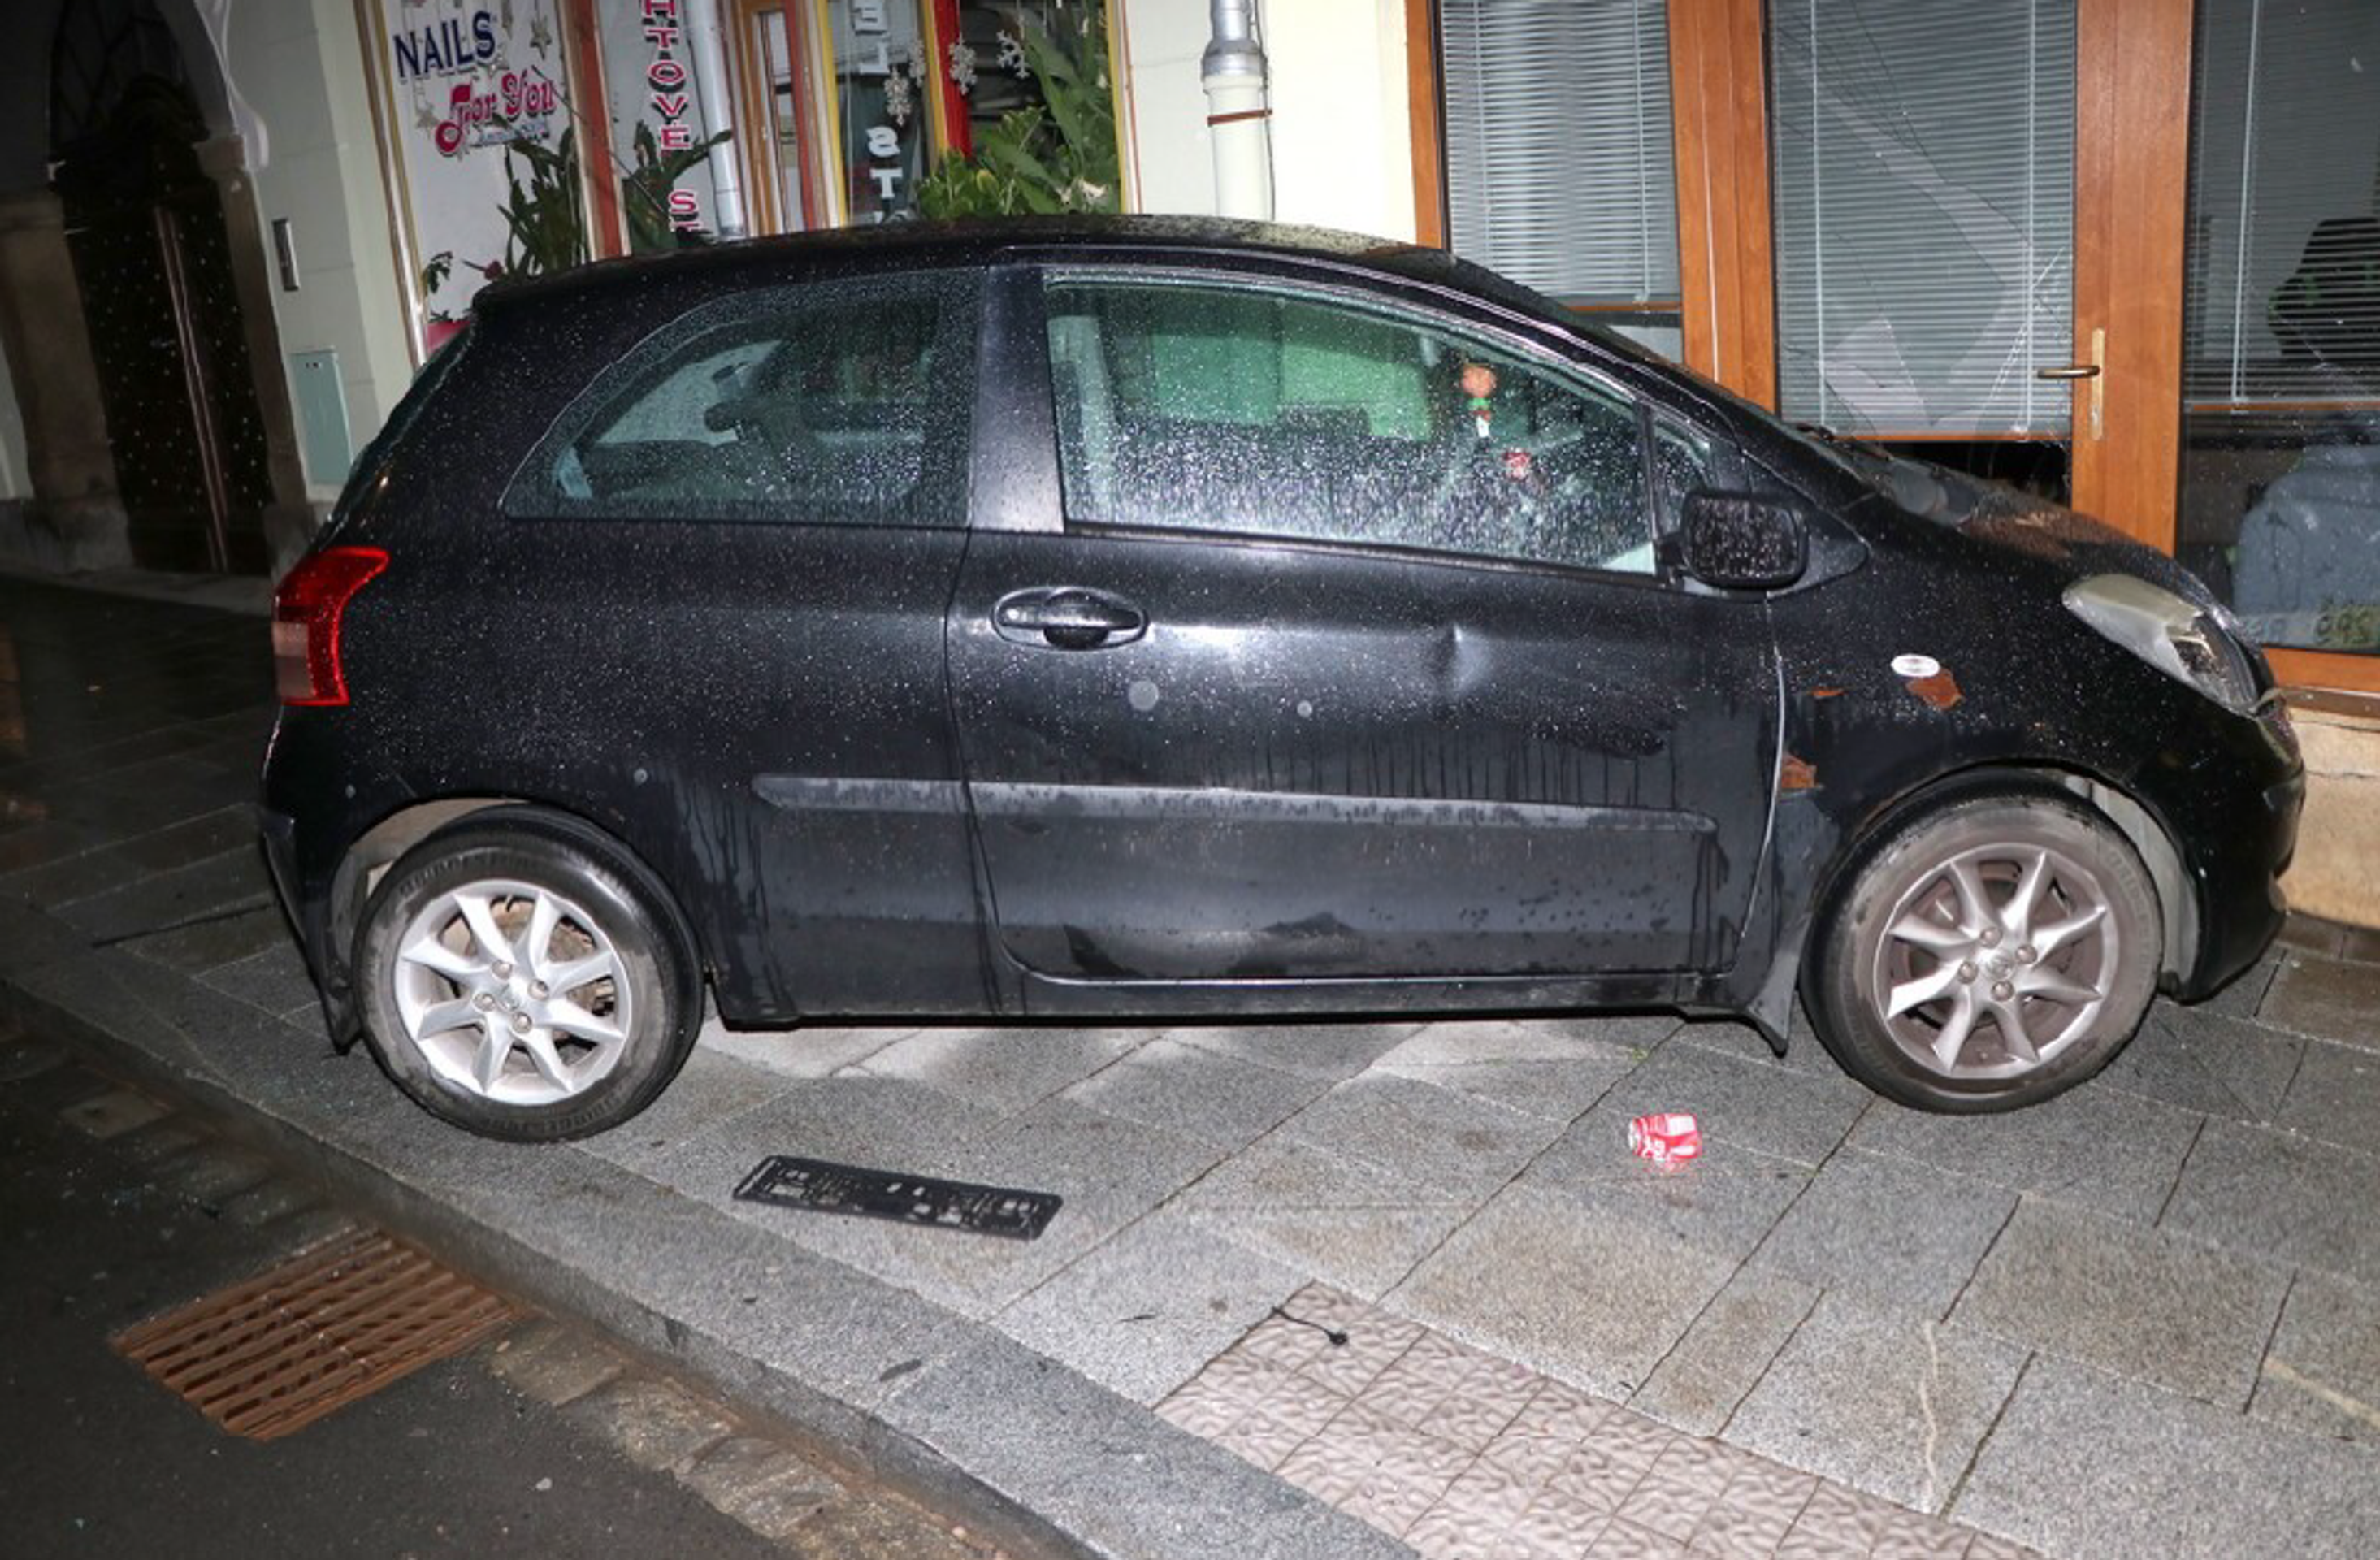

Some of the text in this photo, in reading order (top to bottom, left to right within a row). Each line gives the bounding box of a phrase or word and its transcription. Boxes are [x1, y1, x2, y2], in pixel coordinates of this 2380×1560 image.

[392, 11, 496, 79] NAILS
[436, 84, 497, 154] For
[501, 69, 555, 117] You
